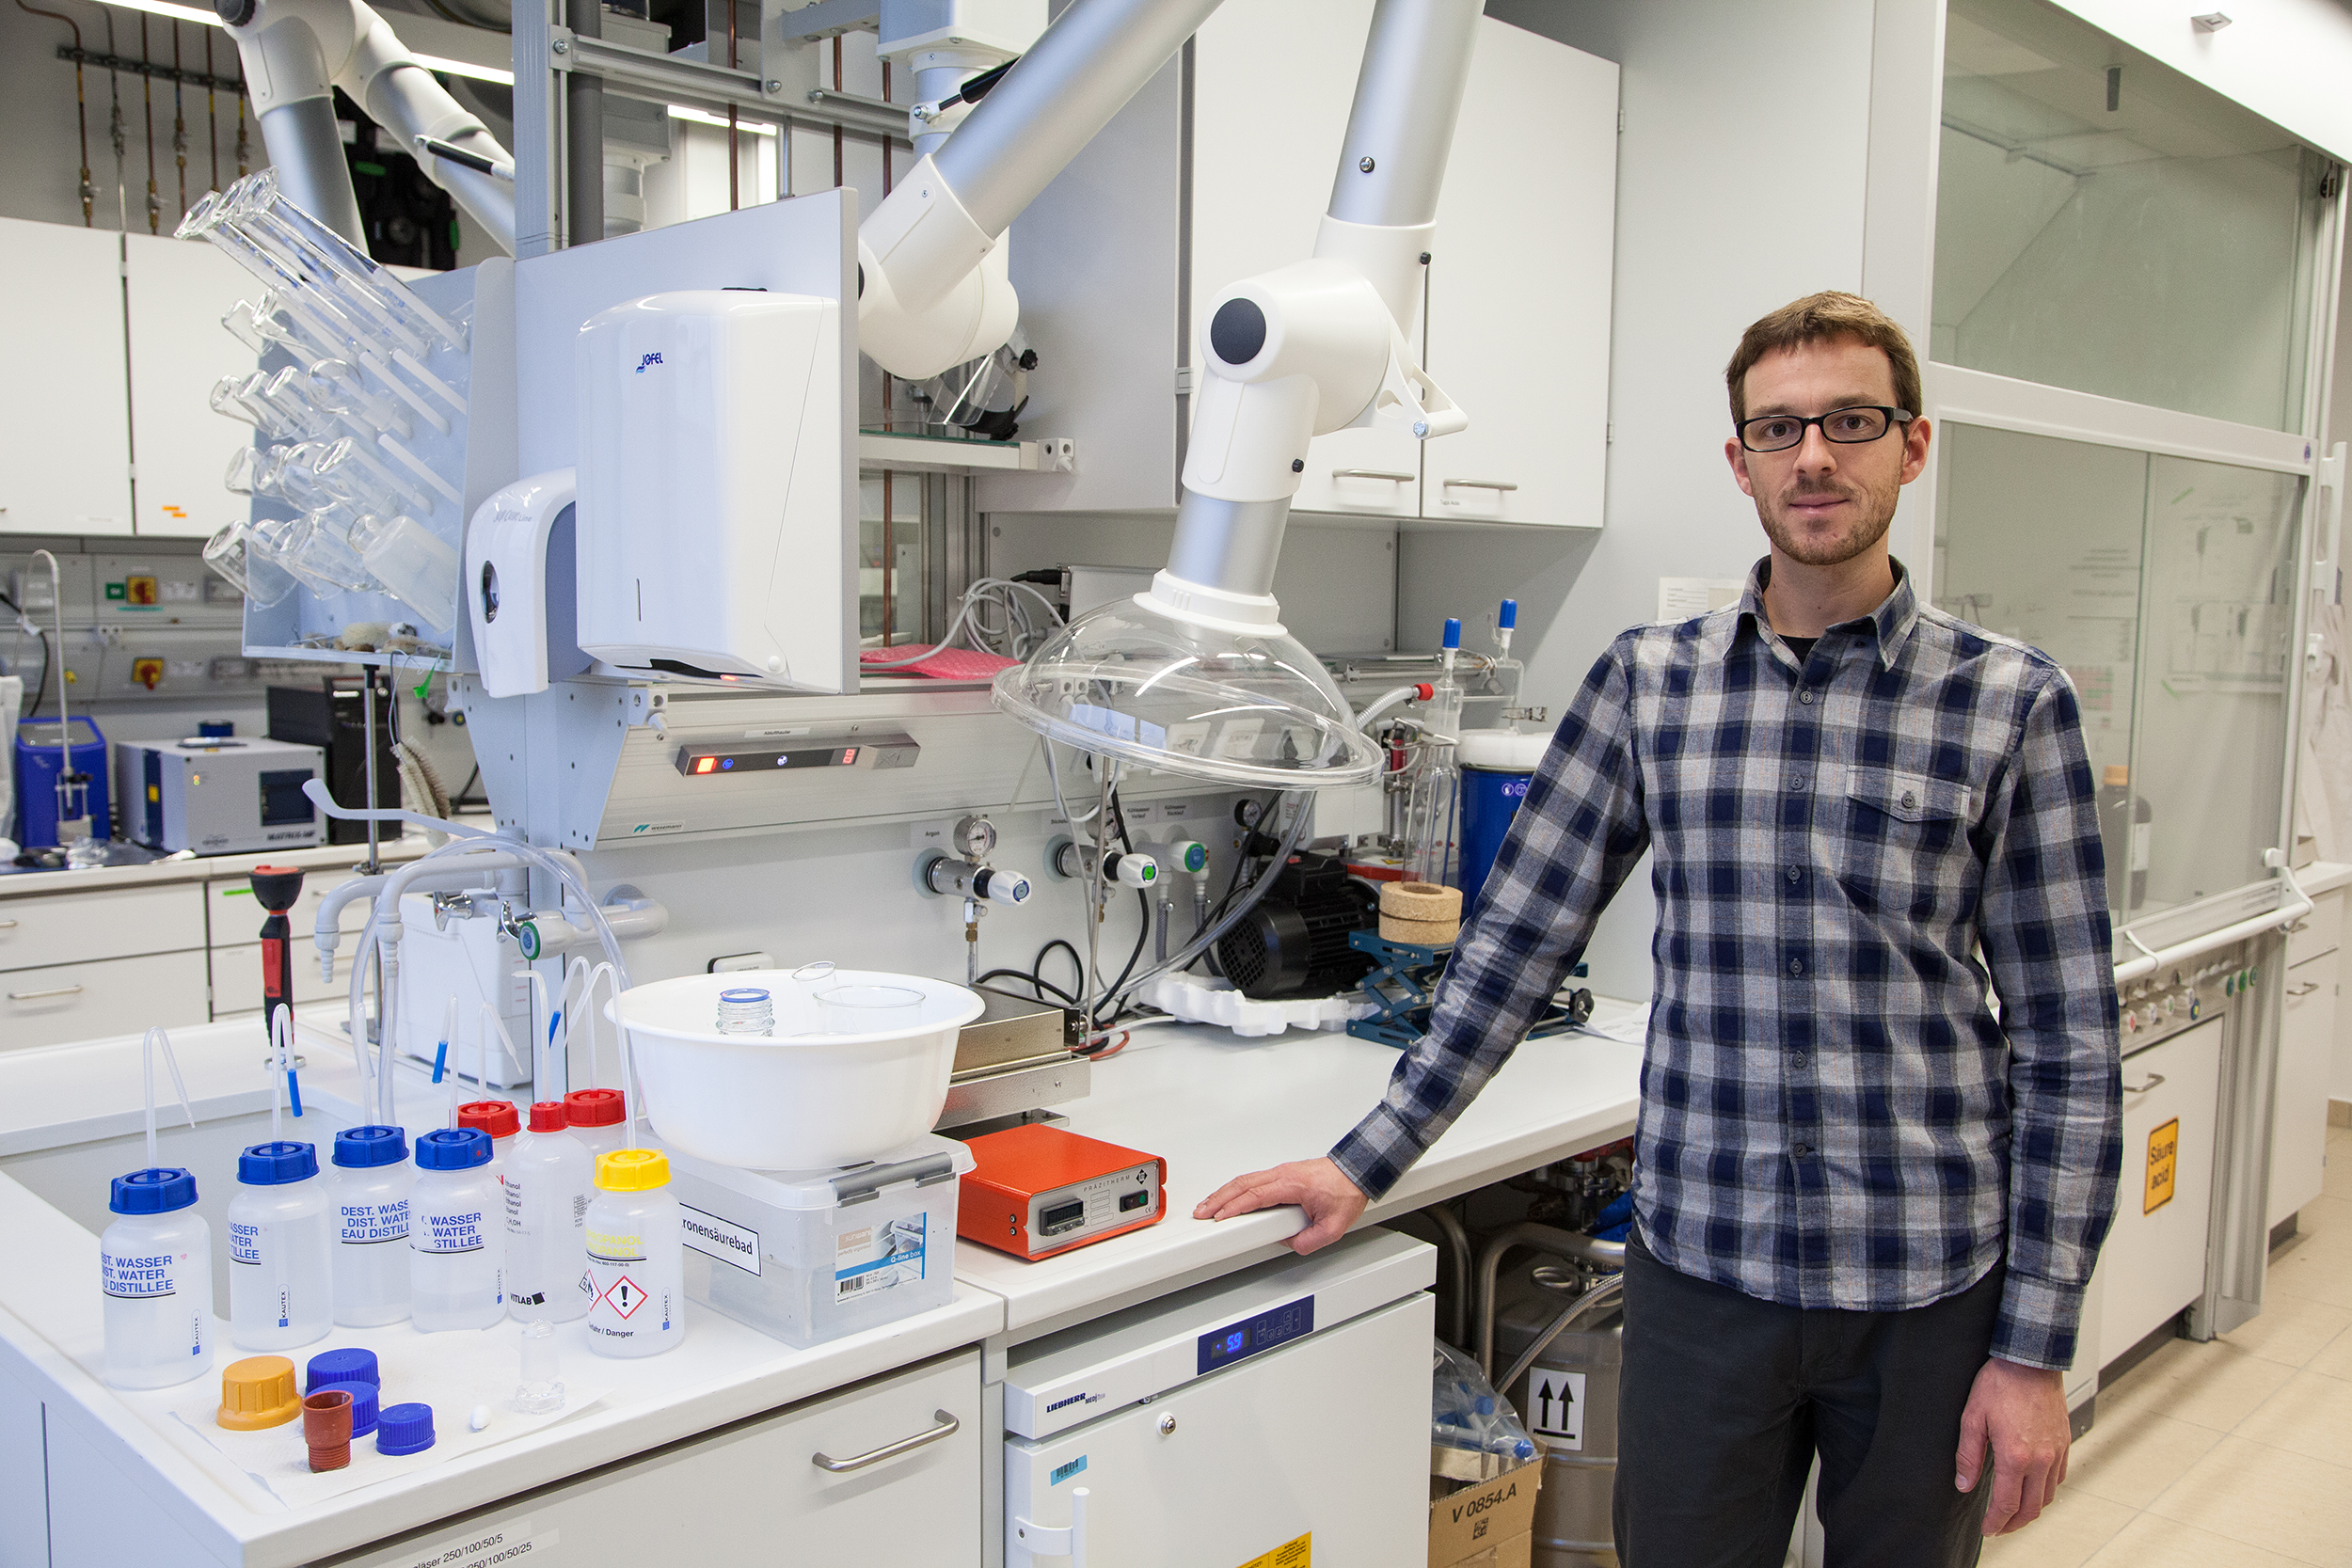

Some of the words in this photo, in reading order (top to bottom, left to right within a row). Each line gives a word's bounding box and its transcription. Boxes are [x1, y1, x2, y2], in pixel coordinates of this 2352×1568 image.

[1083, 1174, 1131, 1193] PRÄZITHERM
[341, 1206, 375, 1217] DEST.
[377, 1198, 409, 1215] WASS
[347, 1217, 378, 1228] DIST.
[380, 1210, 411, 1227] WATE
[430, 1212, 483, 1227] WASSER
[342, 1228, 366, 1240] EAU
[432, 1225, 476, 1238] WATER
[681, 1218, 754, 1256] ronensäurebad
[229, 1232, 253, 1248] ATER
[433, 1234, 484, 1249] STILLEE
[229, 1243, 261, 1260] TILLEE
[890, 1254, 910, 1263] Q-line
[910, 1249, 922, 1258] box
[115, 1255, 173, 1269] WASSER
[118, 1269, 166, 1281] WATER
[109, 1279, 174, 1293] DISTILLEE
[605, 1328, 634, 1339] Danger
[1046, 1392, 1087, 1414] LIEBHERR
[1453, 1505, 1464, 1523] V
[1467, 1481, 1517, 1518] 0854.A
[442, 1532, 504, 1563] 250/100/50/5
